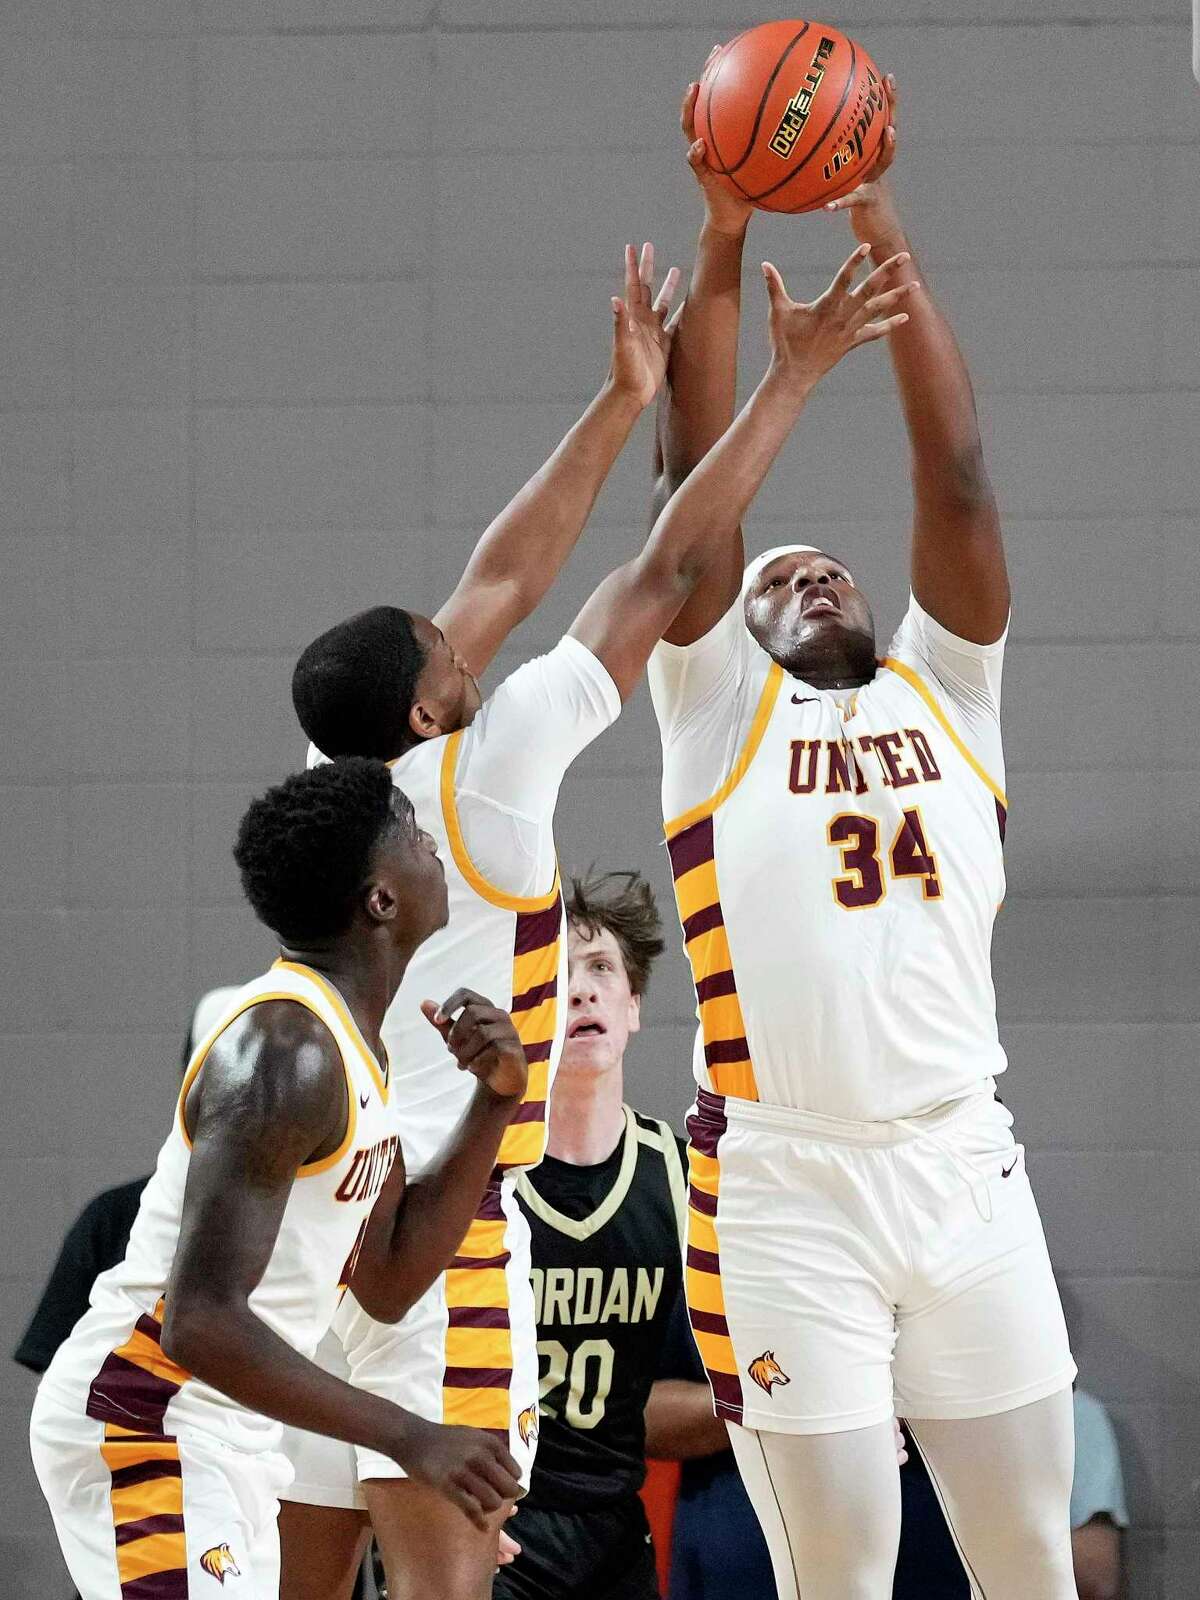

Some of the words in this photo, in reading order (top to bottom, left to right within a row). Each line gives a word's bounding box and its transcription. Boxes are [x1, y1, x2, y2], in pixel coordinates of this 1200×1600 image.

[792, 37, 835, 115] ELITE
[772, 111, 804, 154] PRO
[826, 805, 944, 911] 34
[529, 1267, 665, 1326] RDAN
[536, 1339, 615, 1430] 20
